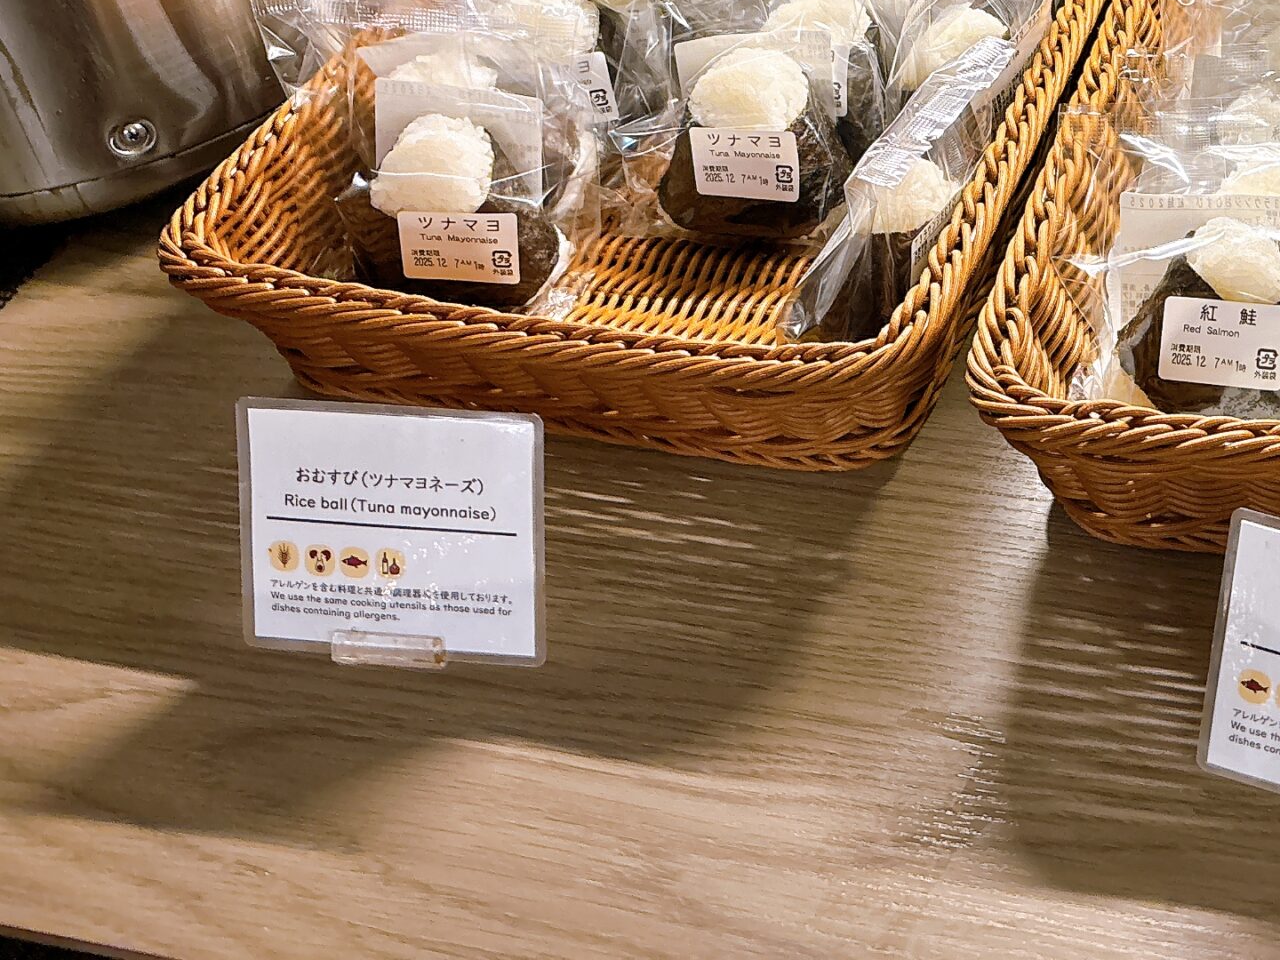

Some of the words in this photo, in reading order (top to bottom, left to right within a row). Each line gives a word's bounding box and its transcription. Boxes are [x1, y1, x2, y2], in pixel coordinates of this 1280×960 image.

[707, 133, 782, 148] ツナマヨ
[734, 151, 781, 159] Mayonnaise
[418, 216, 500, 232] ツナマヨ
[420, 233, 442, 241] Tuna
[447, 235, 498, 244] Mayonnaise
[1183, 324, 1202, 334] Red
[1206, 326, 1240, 338] Salmon
[284, 493, 316, 508] Rice
[400, 505, 497, 522] mayonnaise)
[270, 591, 285, 600] We
[288, 593, 304, 601] use
[307, 594, 321, 603] the
[350, 598, 386, 610] cooking
[389, 601, 426, 611] utensils
[443, 603, 470, 613] those
[473, 607, 495, 615] used
[498, 607, 513, 616] for
[271, 603, 301, 613] dishes
[303, 607, 351, 620] containing
[353, 610, 401, 621] allergens.
[1230, 720, 1246, 733] We
[1249, 728, 1267, 738] use
[1228, 733, 1261, 750] dishes
